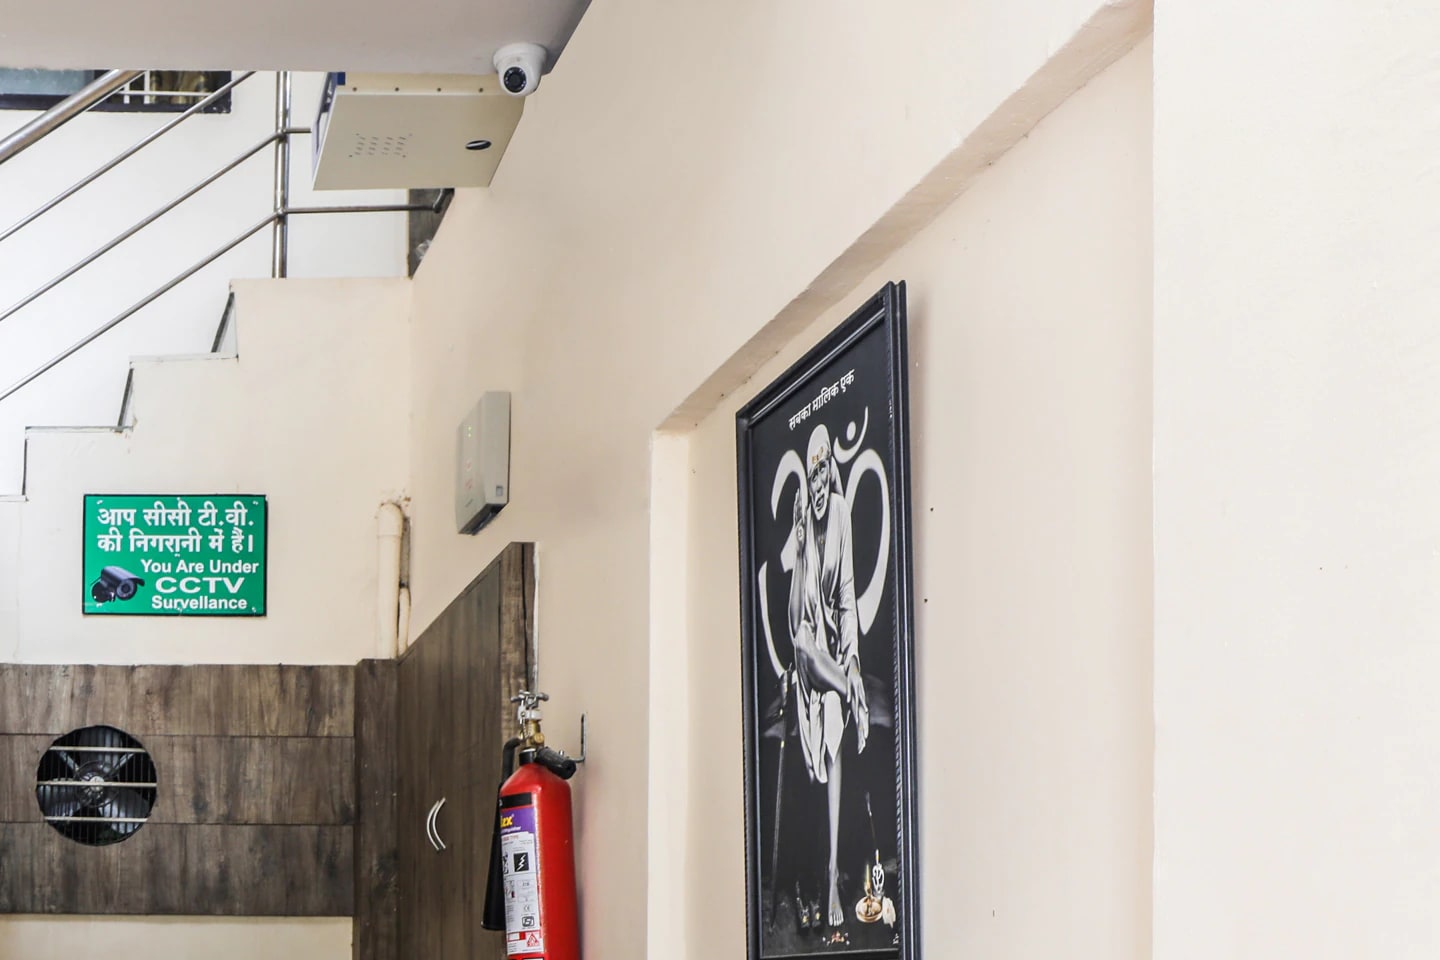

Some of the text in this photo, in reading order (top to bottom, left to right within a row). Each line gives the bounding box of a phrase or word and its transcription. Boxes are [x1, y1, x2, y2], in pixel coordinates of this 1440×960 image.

[788, 369, 855, 430] सबका मालिक एक
[97, 507, 137, 526] आप
[143, 500, 192, 526] सीसी
[97, 527, 123, 552] की
[129, 527, 202, 553] निगरानी
[141, 559, 259, 573] You Are Under
[155, 577, 245, 594] CCTV
